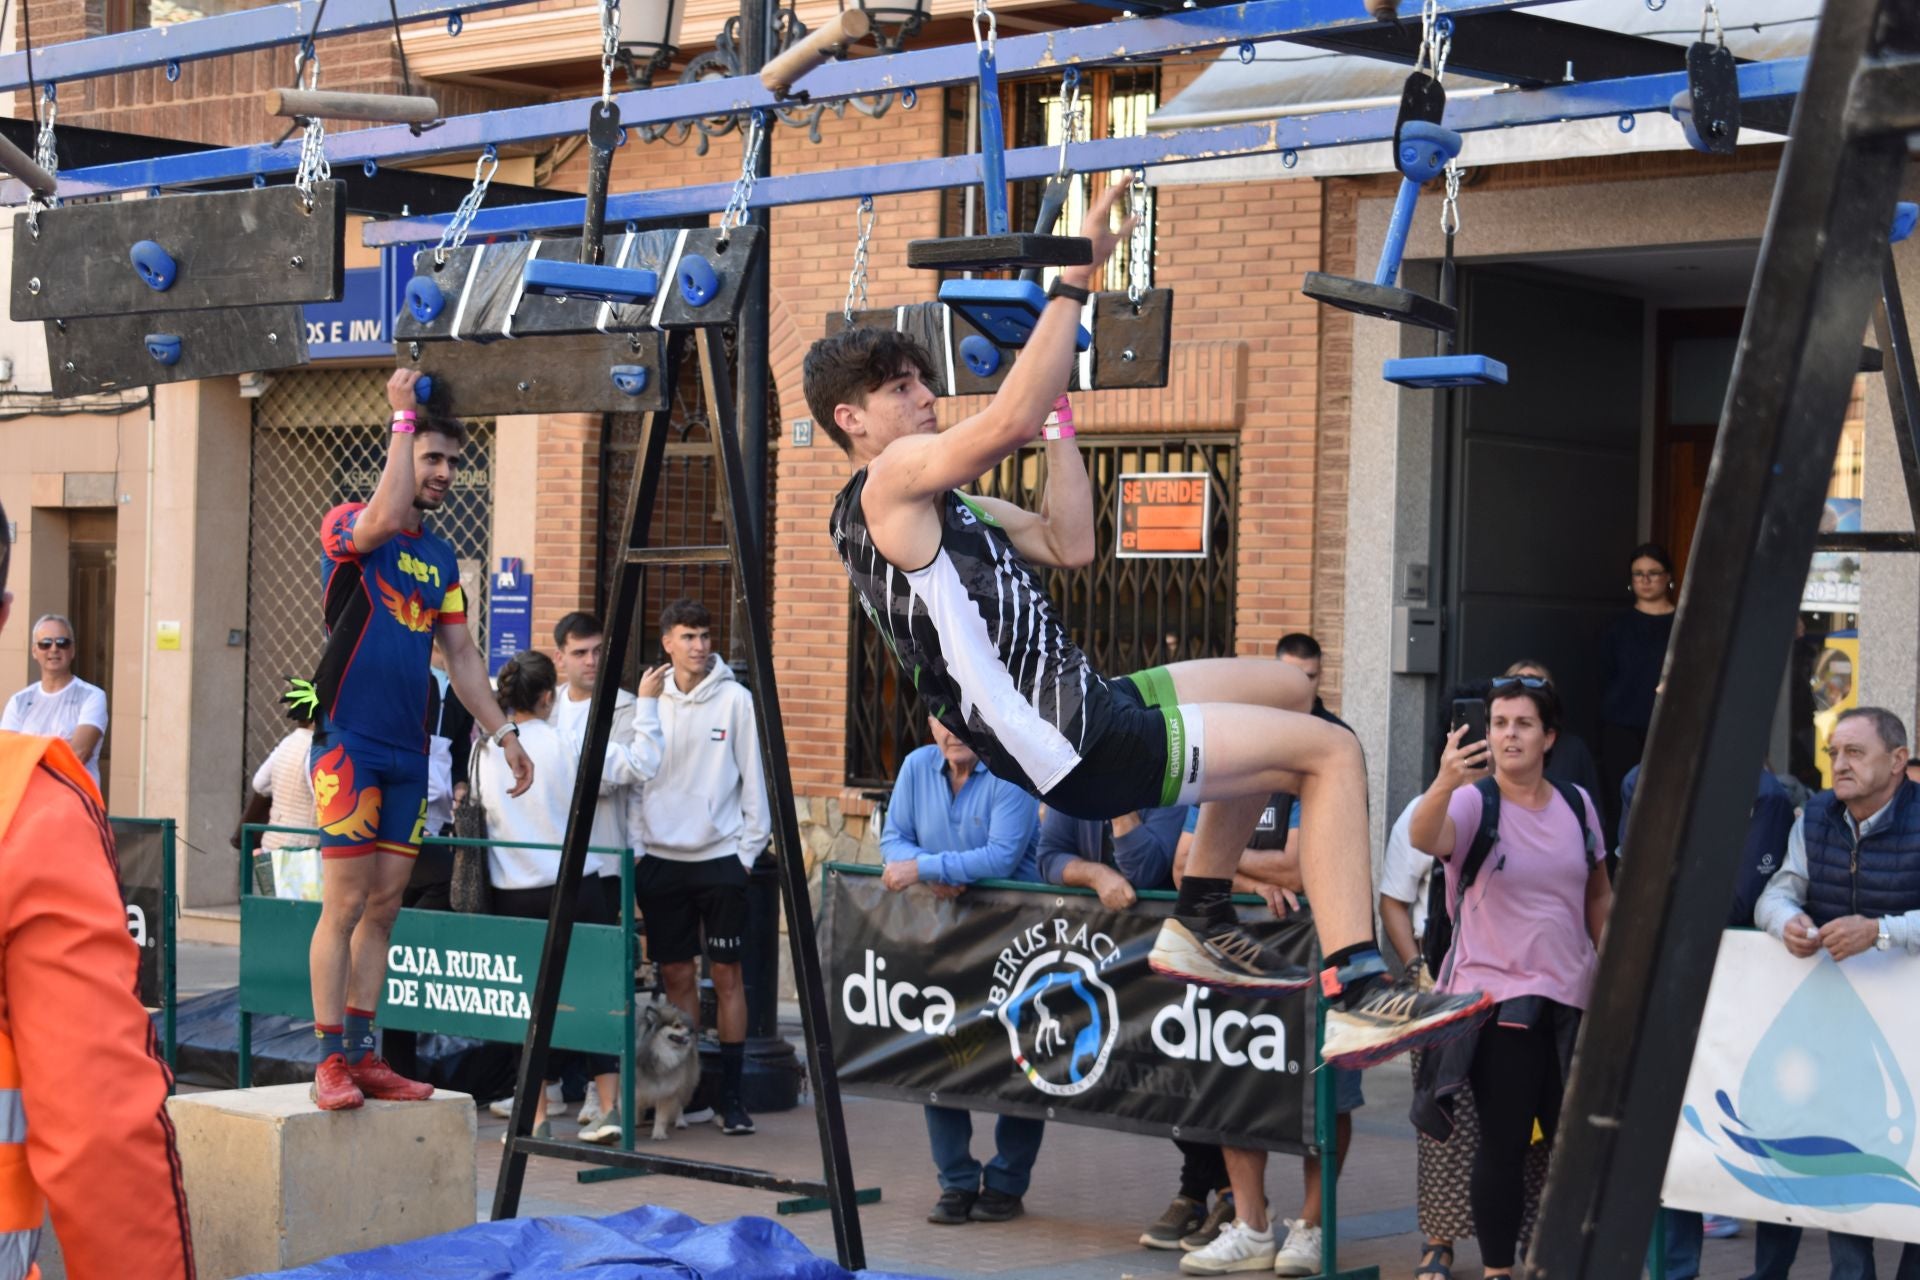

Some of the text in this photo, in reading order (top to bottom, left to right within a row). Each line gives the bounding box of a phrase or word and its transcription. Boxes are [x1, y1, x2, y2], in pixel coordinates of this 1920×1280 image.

[331, 321, 343, 343] E
[1123, 480, 1203, 504] SE VENDE
[388, 945, 523, 984] CAJA RURAL
[979, 918, 1121, 1018] IBERUS RACE
[387, 978, 532, 1019] DE NAVARRA
[842, 949, 956, 1035] dica
[1150, 983, 1286, 1072] dica
